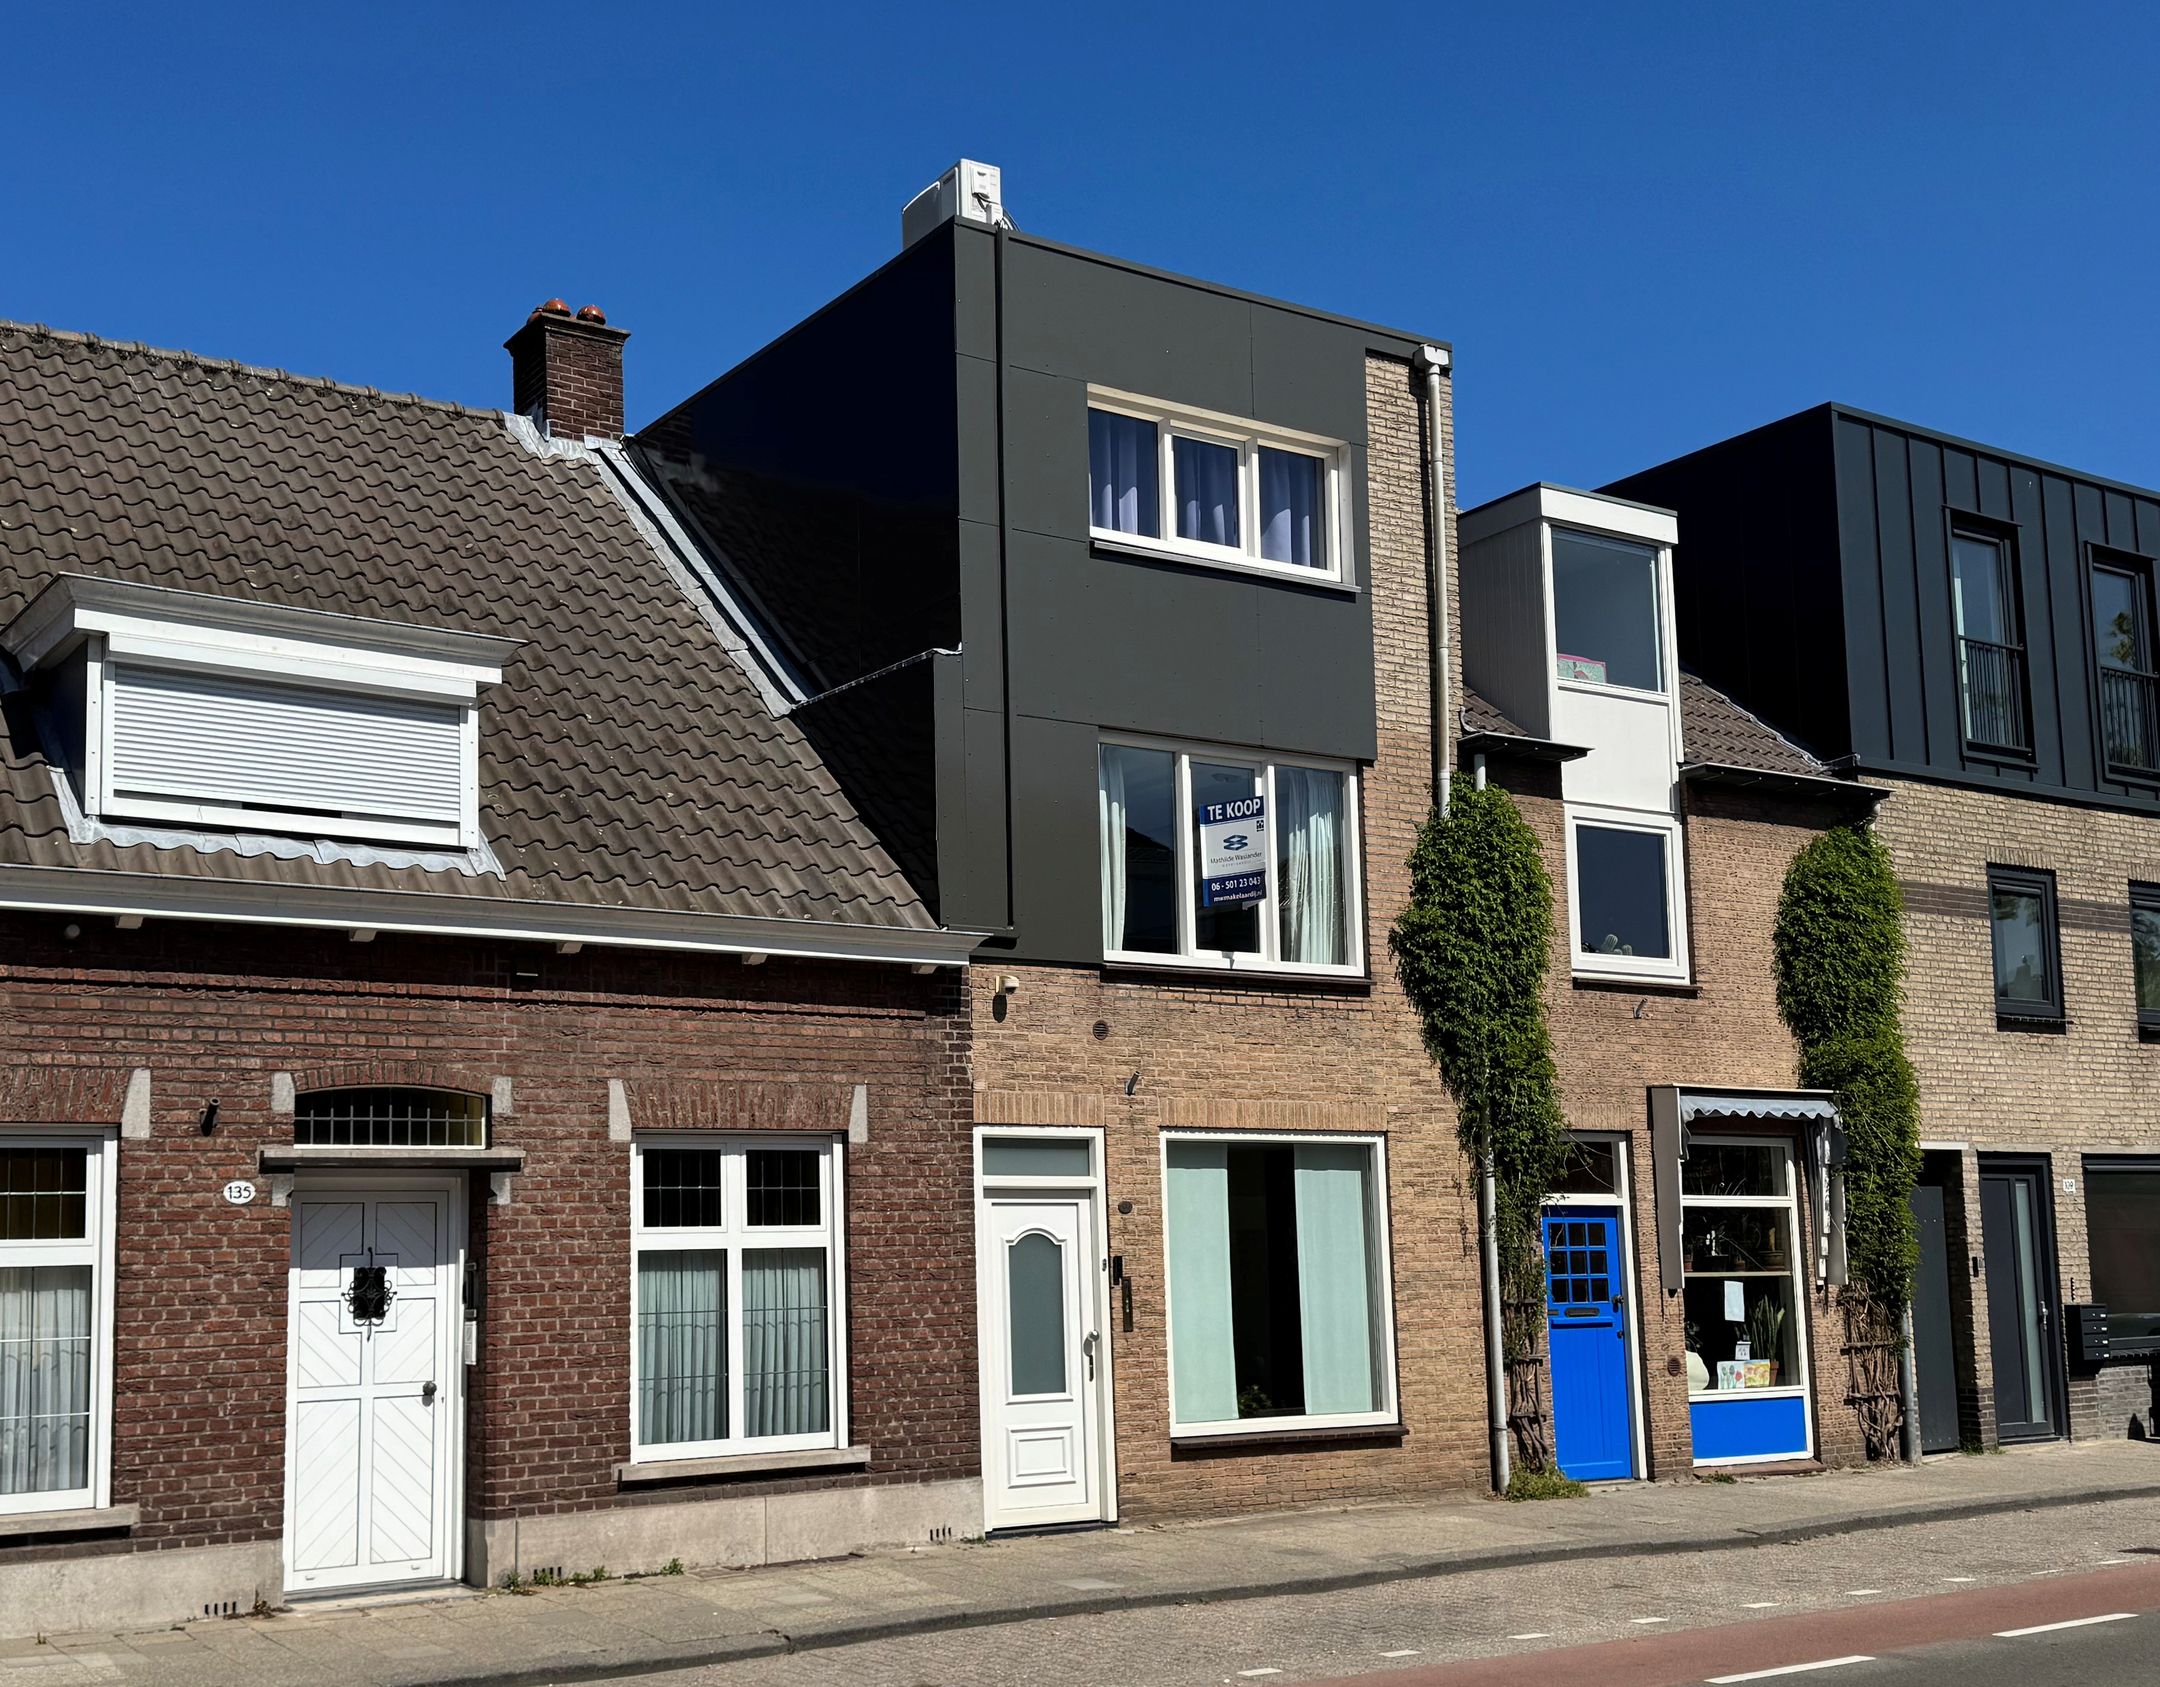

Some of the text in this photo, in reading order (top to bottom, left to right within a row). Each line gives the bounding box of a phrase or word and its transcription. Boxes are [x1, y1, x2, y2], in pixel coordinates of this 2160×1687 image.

[1207, 798, 1261, 820] TE KOOP
[1211, 882, 1221, 891] 06
[1225, 880, 1237, 889] 501
[1239, 878, 1247, 887] 23
[1249, 876, 1261, 885] 043
[227, 1185, 252, 1199] 135
